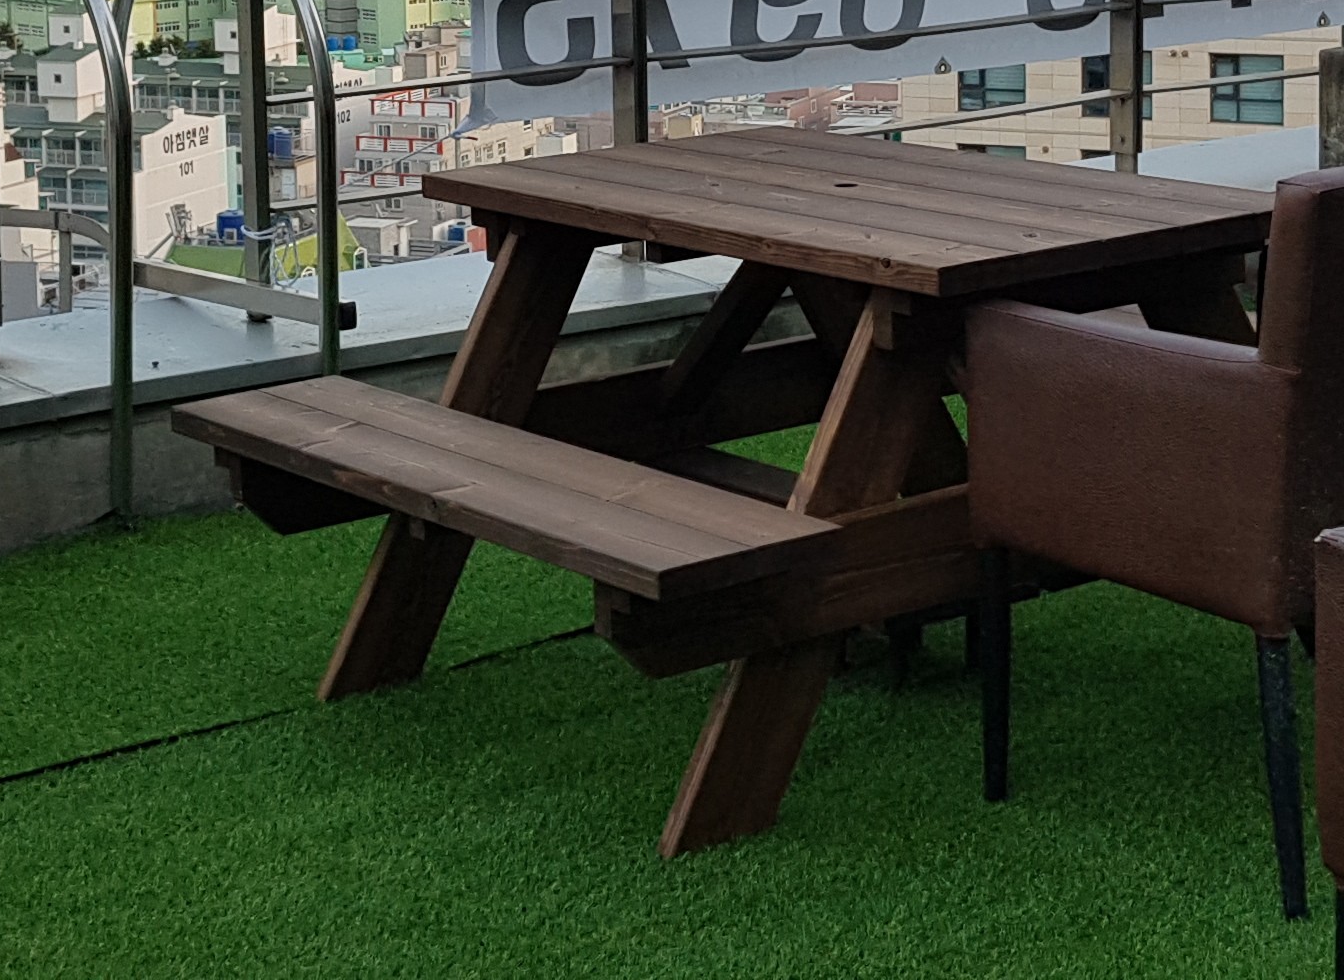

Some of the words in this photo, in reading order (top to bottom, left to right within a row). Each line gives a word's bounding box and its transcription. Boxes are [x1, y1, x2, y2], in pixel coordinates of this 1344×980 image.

[336, 109, 351, 125] 102
[162, 124, 210, 155] 아침햇살
[178, 159, 195, 178] 101
